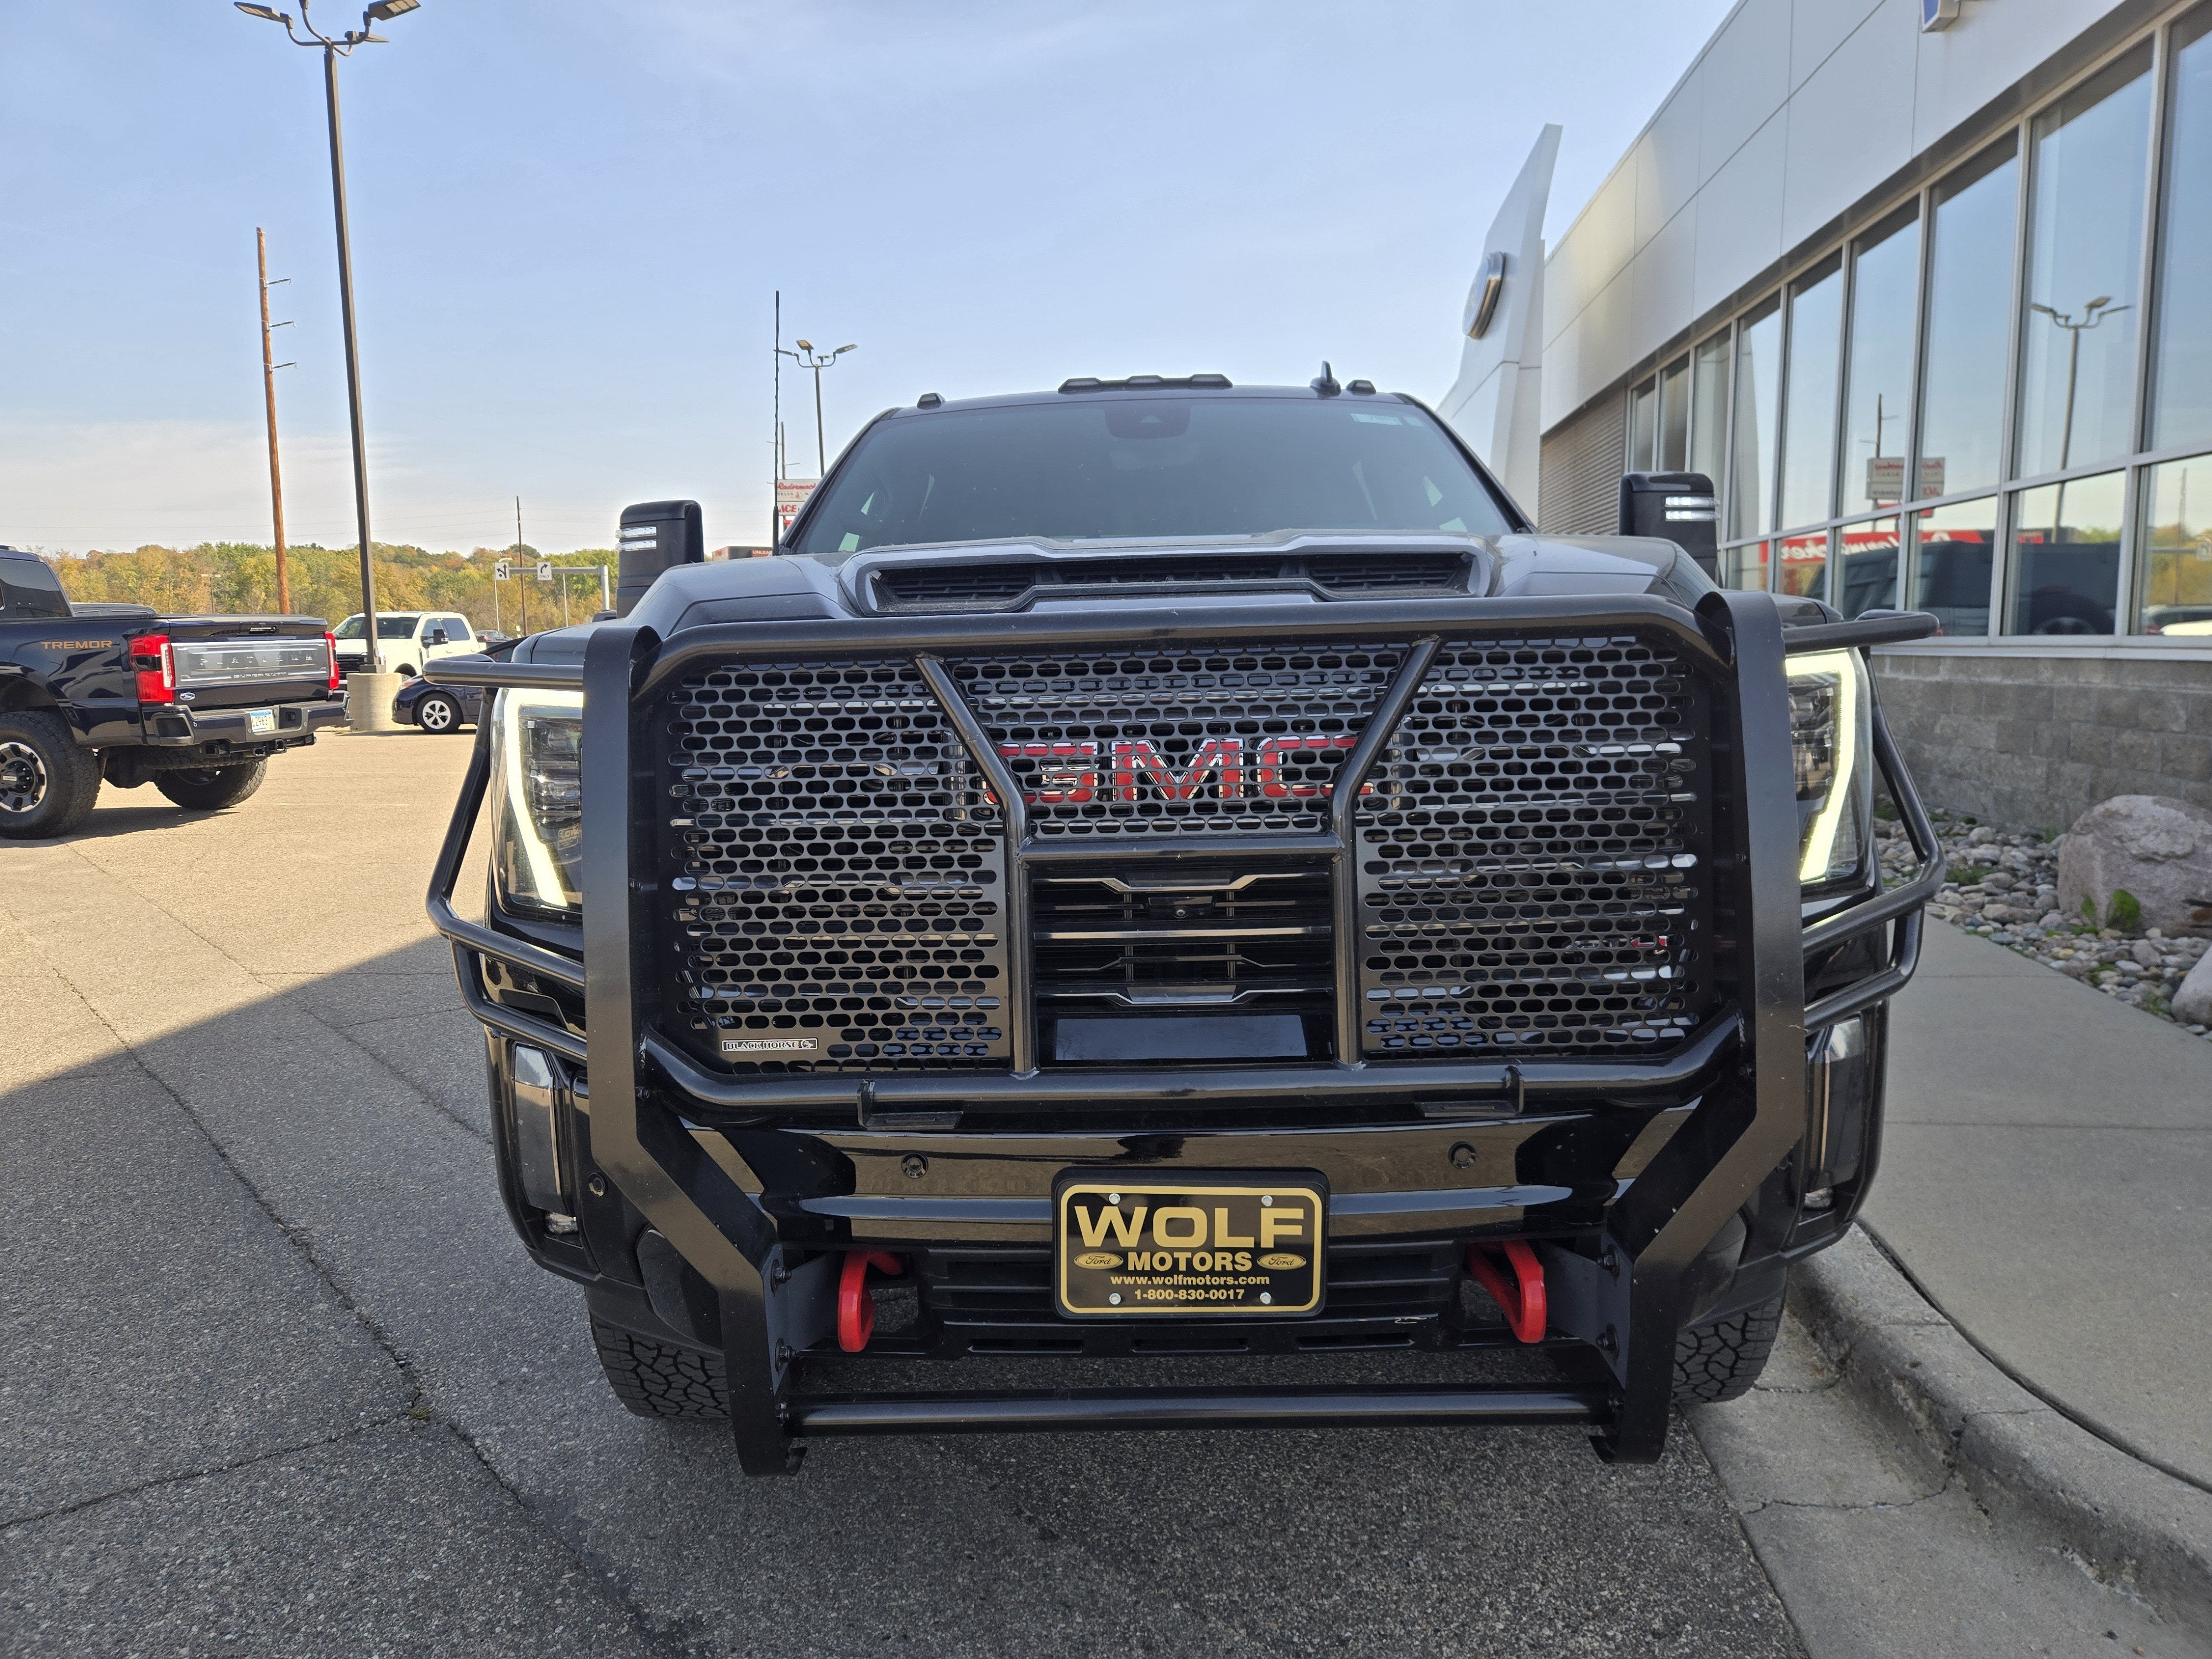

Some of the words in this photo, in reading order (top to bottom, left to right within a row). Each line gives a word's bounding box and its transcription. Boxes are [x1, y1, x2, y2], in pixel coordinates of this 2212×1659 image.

[779, 504, 797, 513] ACE
[41, 640, 112, 649] TREMOR
[982, 734, 1375, 805] GMC
[726, 1041, 763, 1050] BLACK
[763, 1040, 799, 1050] HORSE
[1074, 1206, 1305, 1248] WOLF
[1128, 1251, 1253, 1271] MOTORS
[1110, 1275, 1270, 1285] www.wolfmotors.com
[1135, 1288, 1245, 1300] 1-800-830-0017
